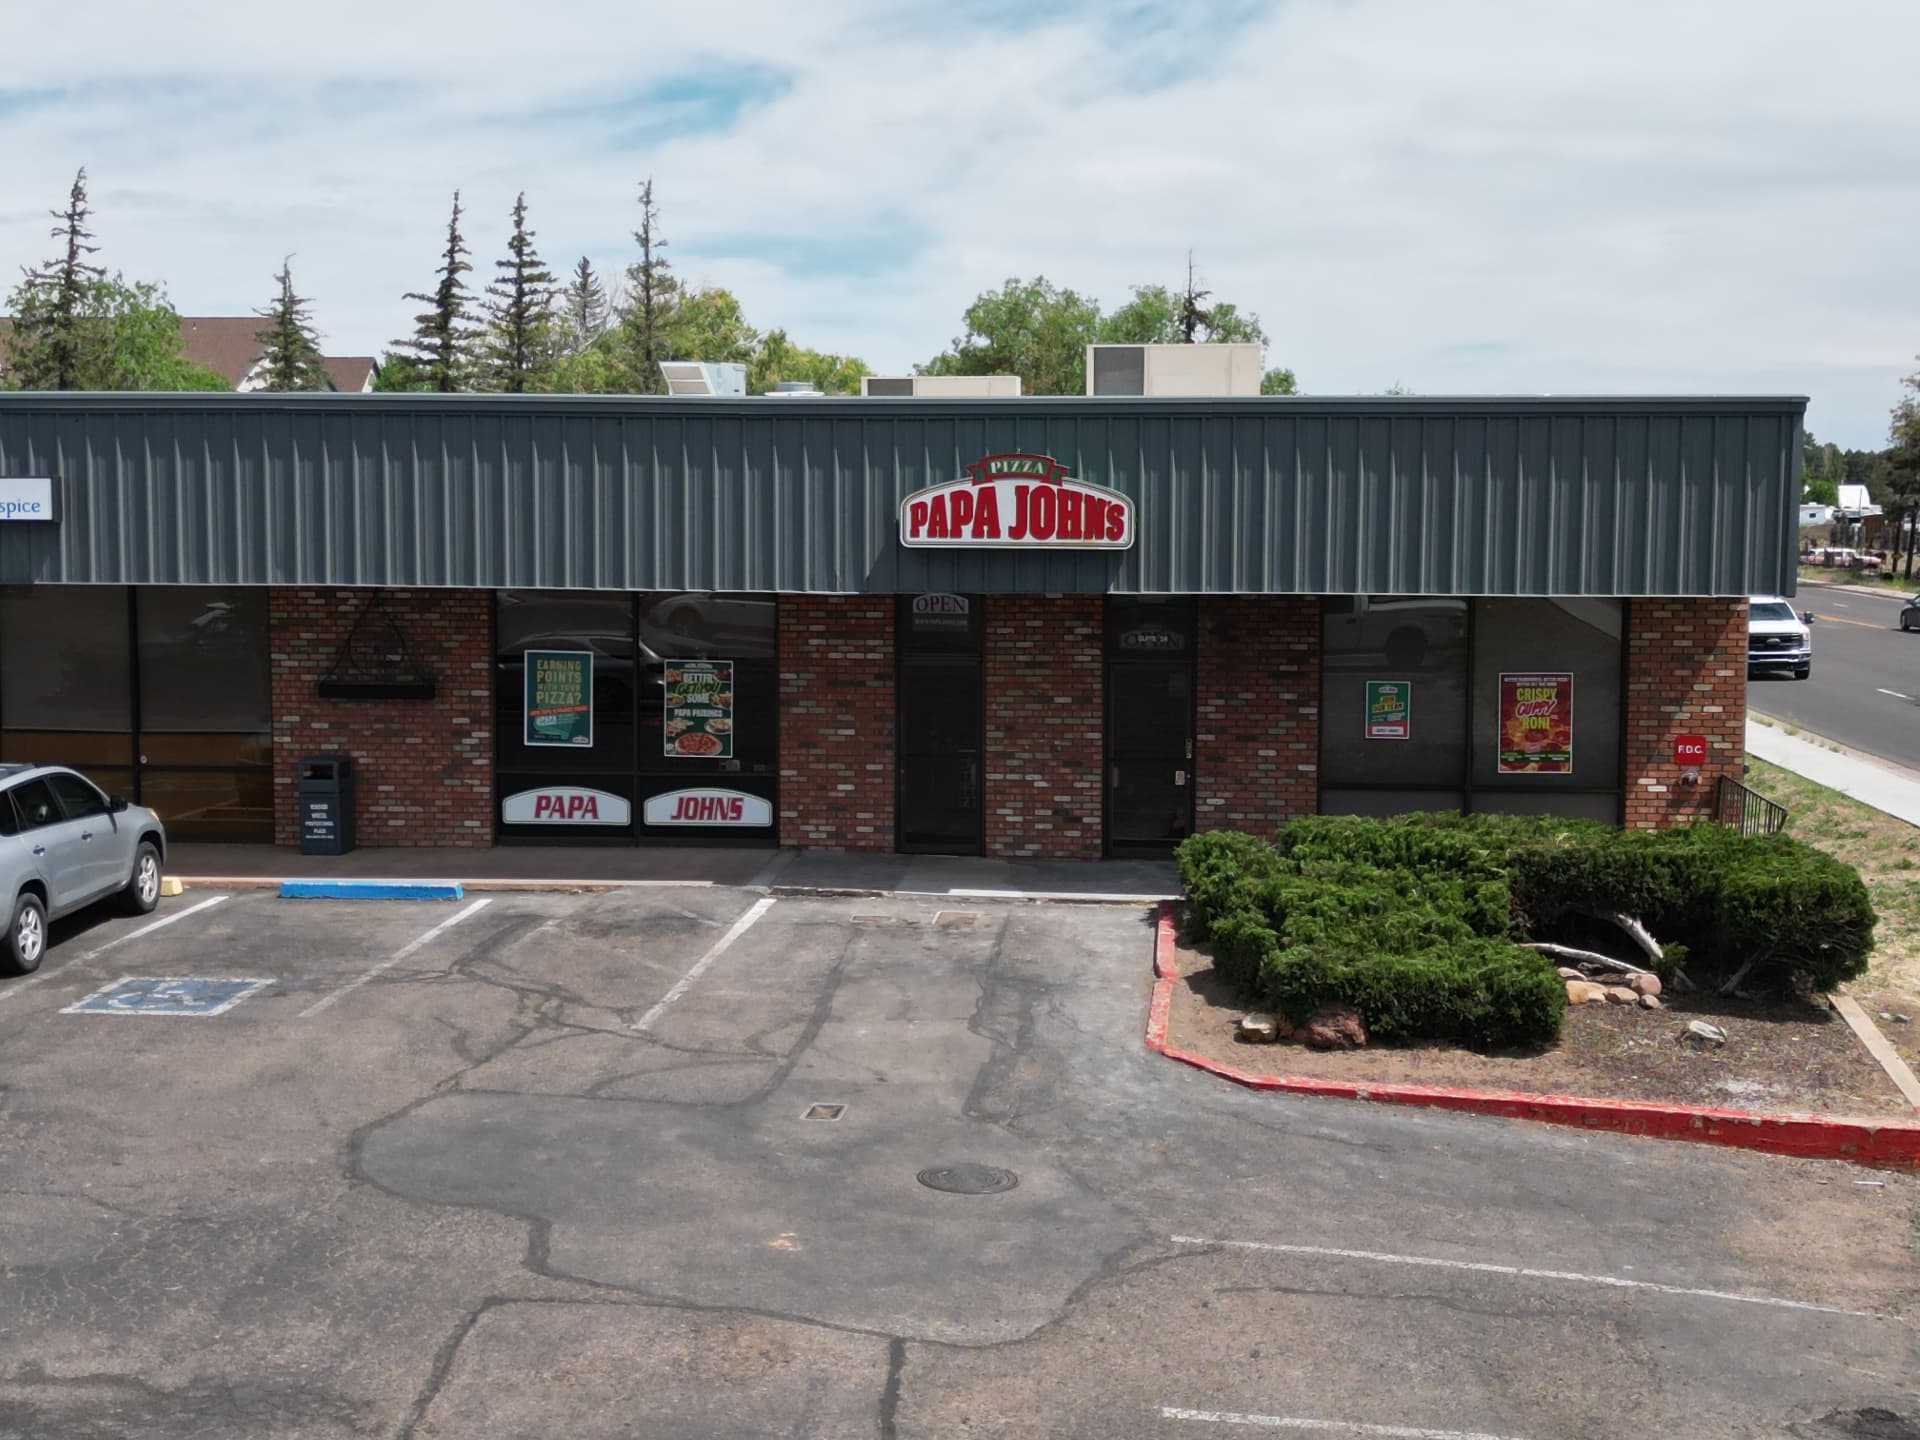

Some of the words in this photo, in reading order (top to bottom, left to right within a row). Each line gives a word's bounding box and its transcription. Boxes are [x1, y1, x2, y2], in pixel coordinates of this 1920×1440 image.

[990, 460, 1045, 474] PIZZA
[910, 486, 1001, 539] PAPA
[1008, 485, 1125, 541] JOHN'S
[916, 595, 965, 611] OPEN
[536, 660, 582, 670] EARNING
[536, 671, 582, 683] POINTS
[536, 692, 582, 705] PIZZA?
[1517, 687, 1557, 700] CRISPY
[534, 795, 599, 819] PAPA
